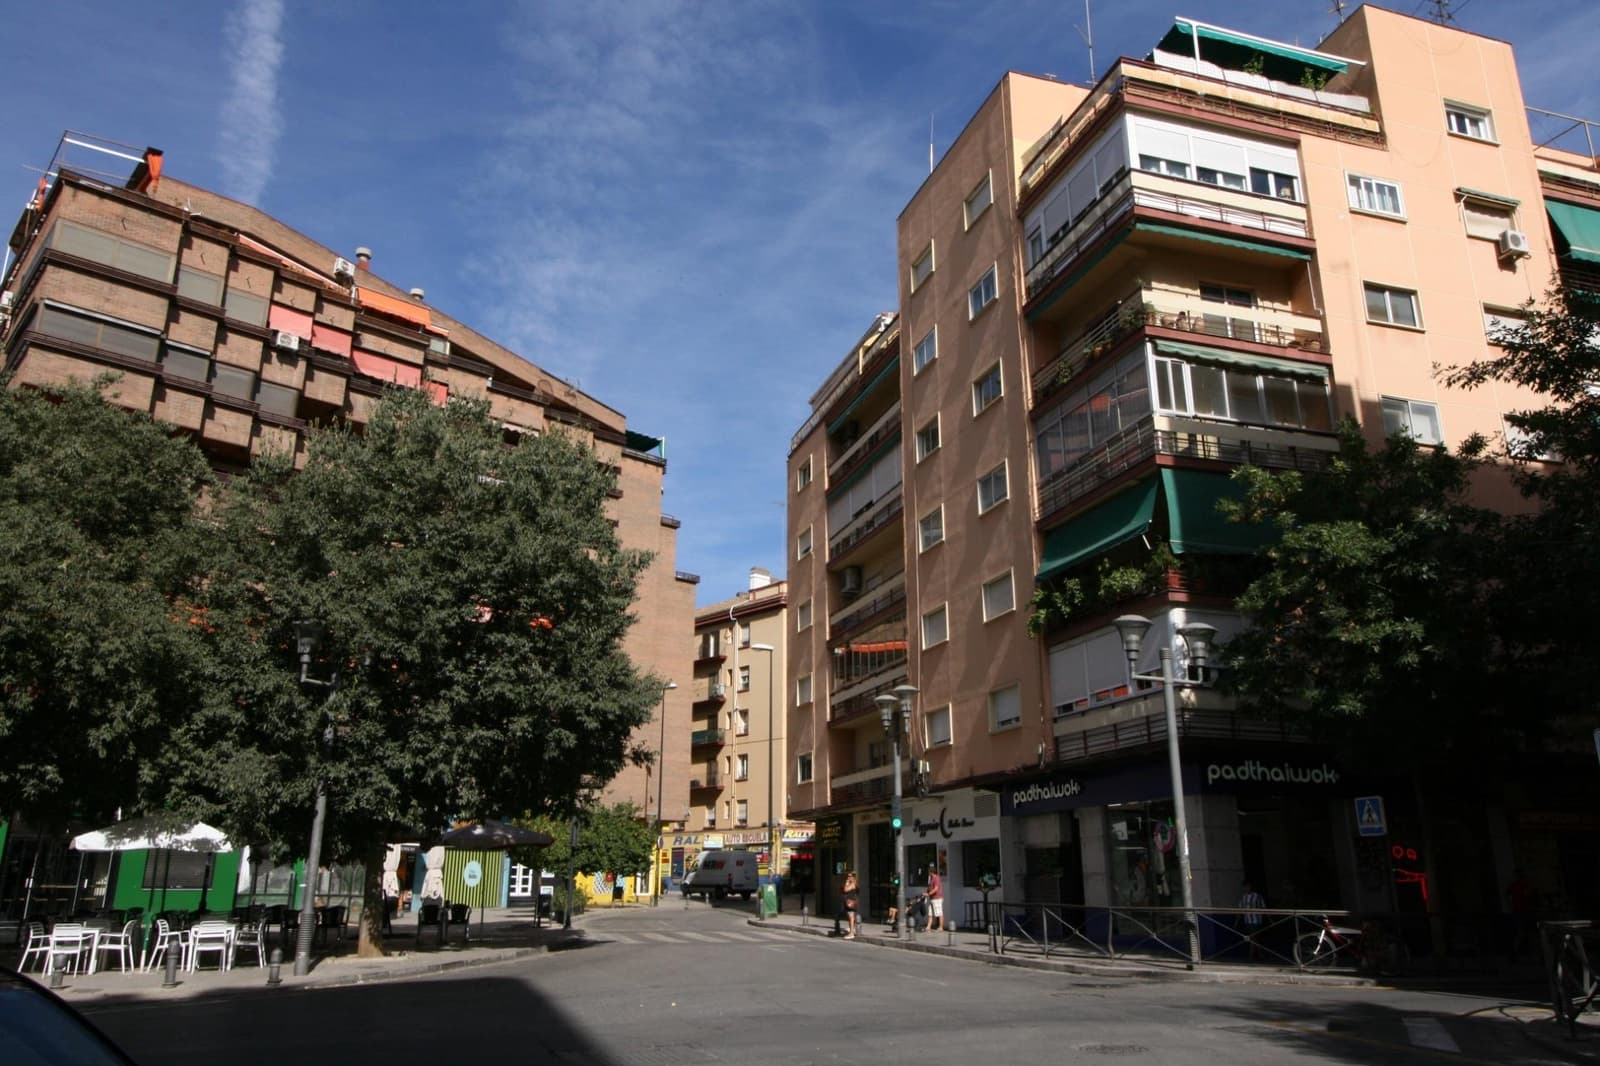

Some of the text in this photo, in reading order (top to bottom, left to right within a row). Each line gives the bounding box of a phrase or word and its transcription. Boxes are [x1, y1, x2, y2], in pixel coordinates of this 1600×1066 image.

[1207, 759, 1337, 785] padthaiwok
[1013, 779, 1079, 809] padthaiwok
[784, 828, 814, 838] RALLY
